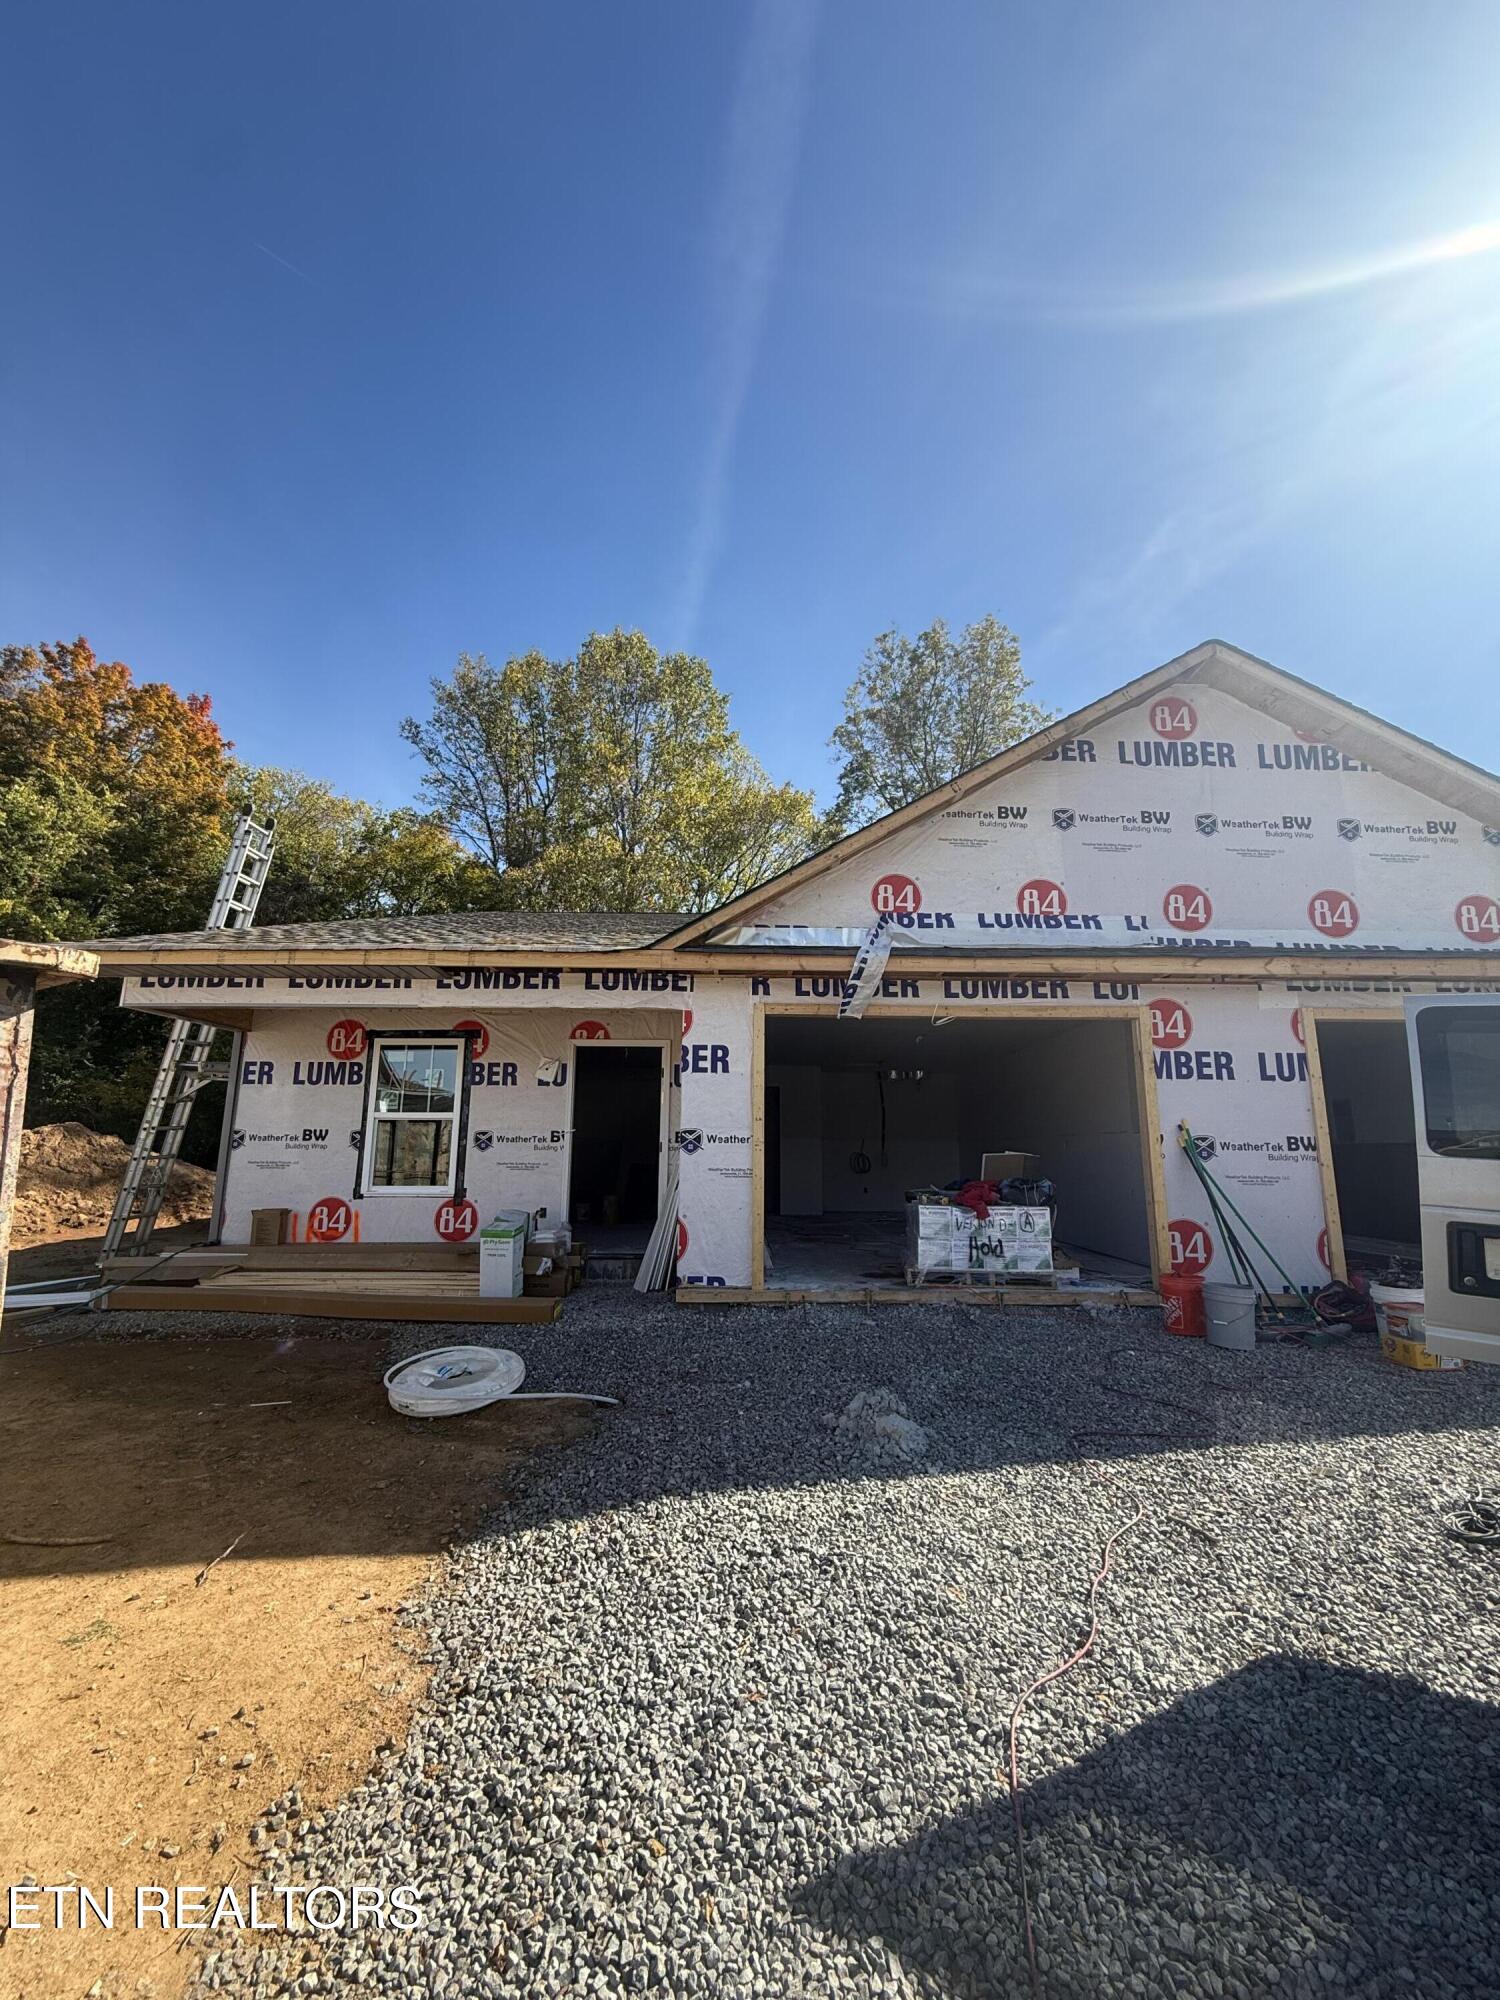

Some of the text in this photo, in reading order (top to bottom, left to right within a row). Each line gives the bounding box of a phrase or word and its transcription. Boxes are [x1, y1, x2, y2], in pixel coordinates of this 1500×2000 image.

[1154, 705, 1192, 732] 84
[1118, 741, 1237, 768] LUMBER
[1257, 743, 1383, 772] LUMBE
[942, 806, 1028, 820] eatherTek BW
[1079, 811, 1171, 825] WeatherTek BW
[1221, 816, 1312, 830] WeatherTek BW
[979, 820, 1028, 830] Building Wrap
[1122, 825, 1172, 835] Building Wrap
[1265, 830, 1314, 840] Building Wrap
[1364, 821, 1456, 835] WeatherTek BW
[1409, 835, 1459, 845] Building Wrap
[877, 884, 916, 912] 84
[1023, 889, 1062, 916] 84
[1168, 894, 1207, 923] 84
[1314, 899, 1353, 928] 84
[1461, 905, 1500, 934] 84
[943, 978, 1069, 999] LUMBER
[331, 1028, 364, 1053] 84
[292, 1061, 363, 1086] LUMB
[249, 1128, 329, 1142] WeatherTek BW
[496, 1135, 548, 1144] WeatherTek
[1219, 1135, 1318, 1152] WeatherTek BW
[1268, 1153, 1299, 1163] Building
[313, 1206, 347, 1233] 84
[438, 1207, 473, 1233] 84
[968, 1235, 1007, 1263] Hold
